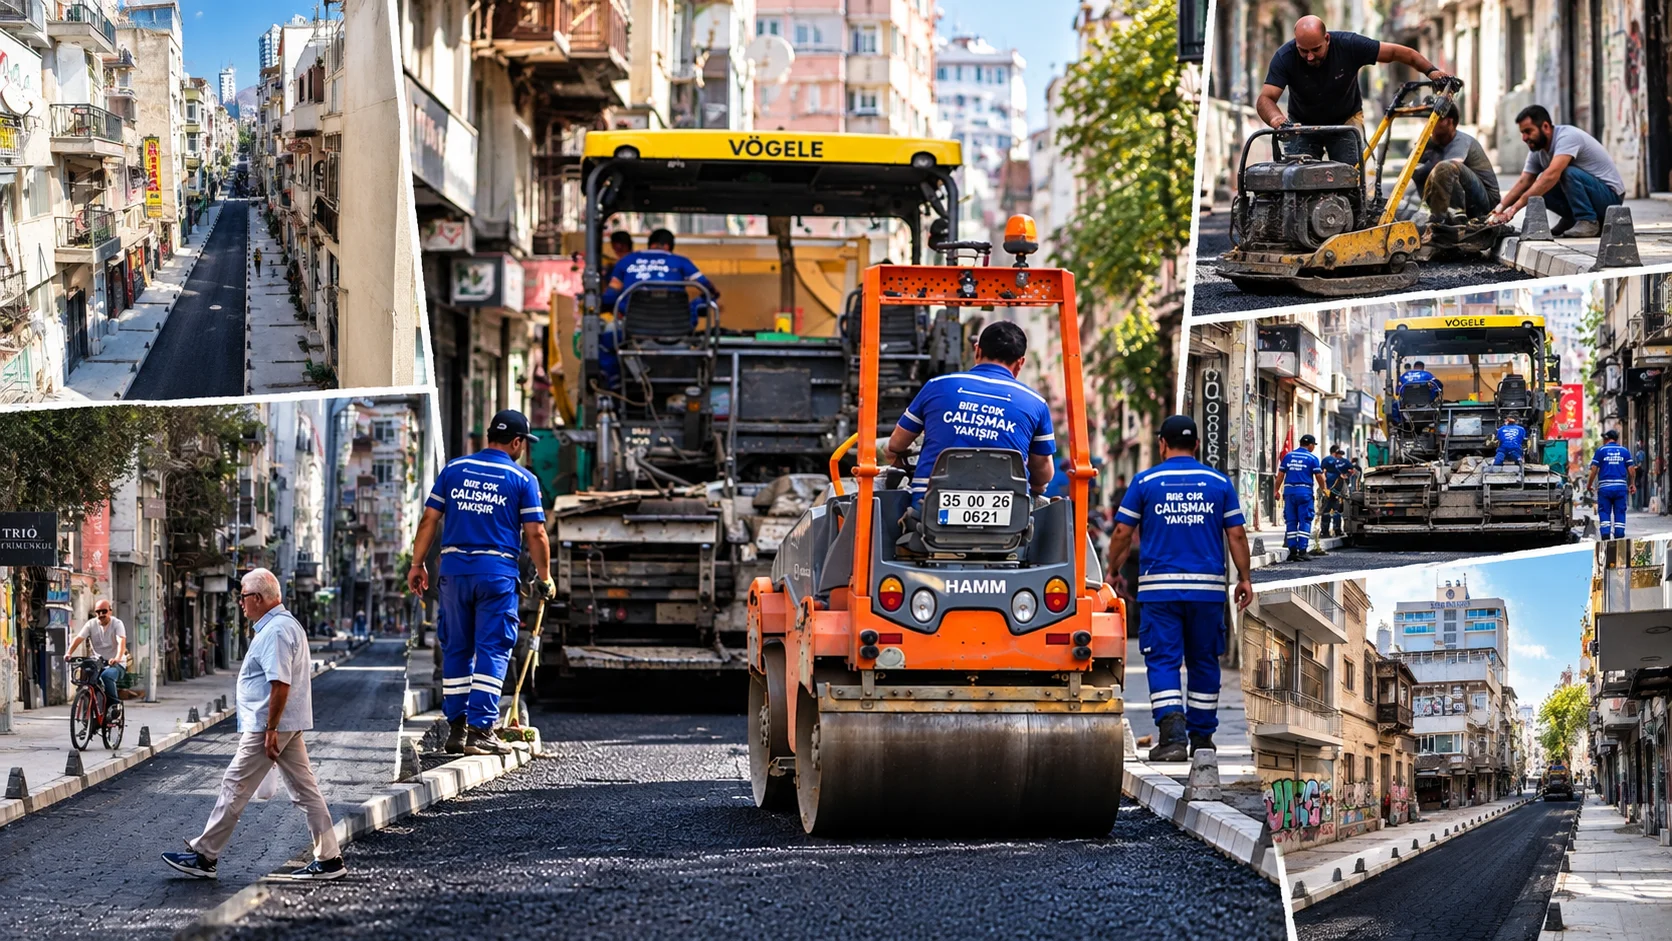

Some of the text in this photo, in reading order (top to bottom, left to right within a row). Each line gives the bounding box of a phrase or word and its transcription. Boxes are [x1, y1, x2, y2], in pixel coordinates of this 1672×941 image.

[728, 135, 824, 158] VÖGELE
[953, 425, 999, 441] YAKIŞIR
[942, 494, 1010, 508] 35 00 26
[963, 511, 998, 523] 0621
[1164, 514, 1205, 527] YAKIŞIR
[945, 579, 1007, 594] HAMM
